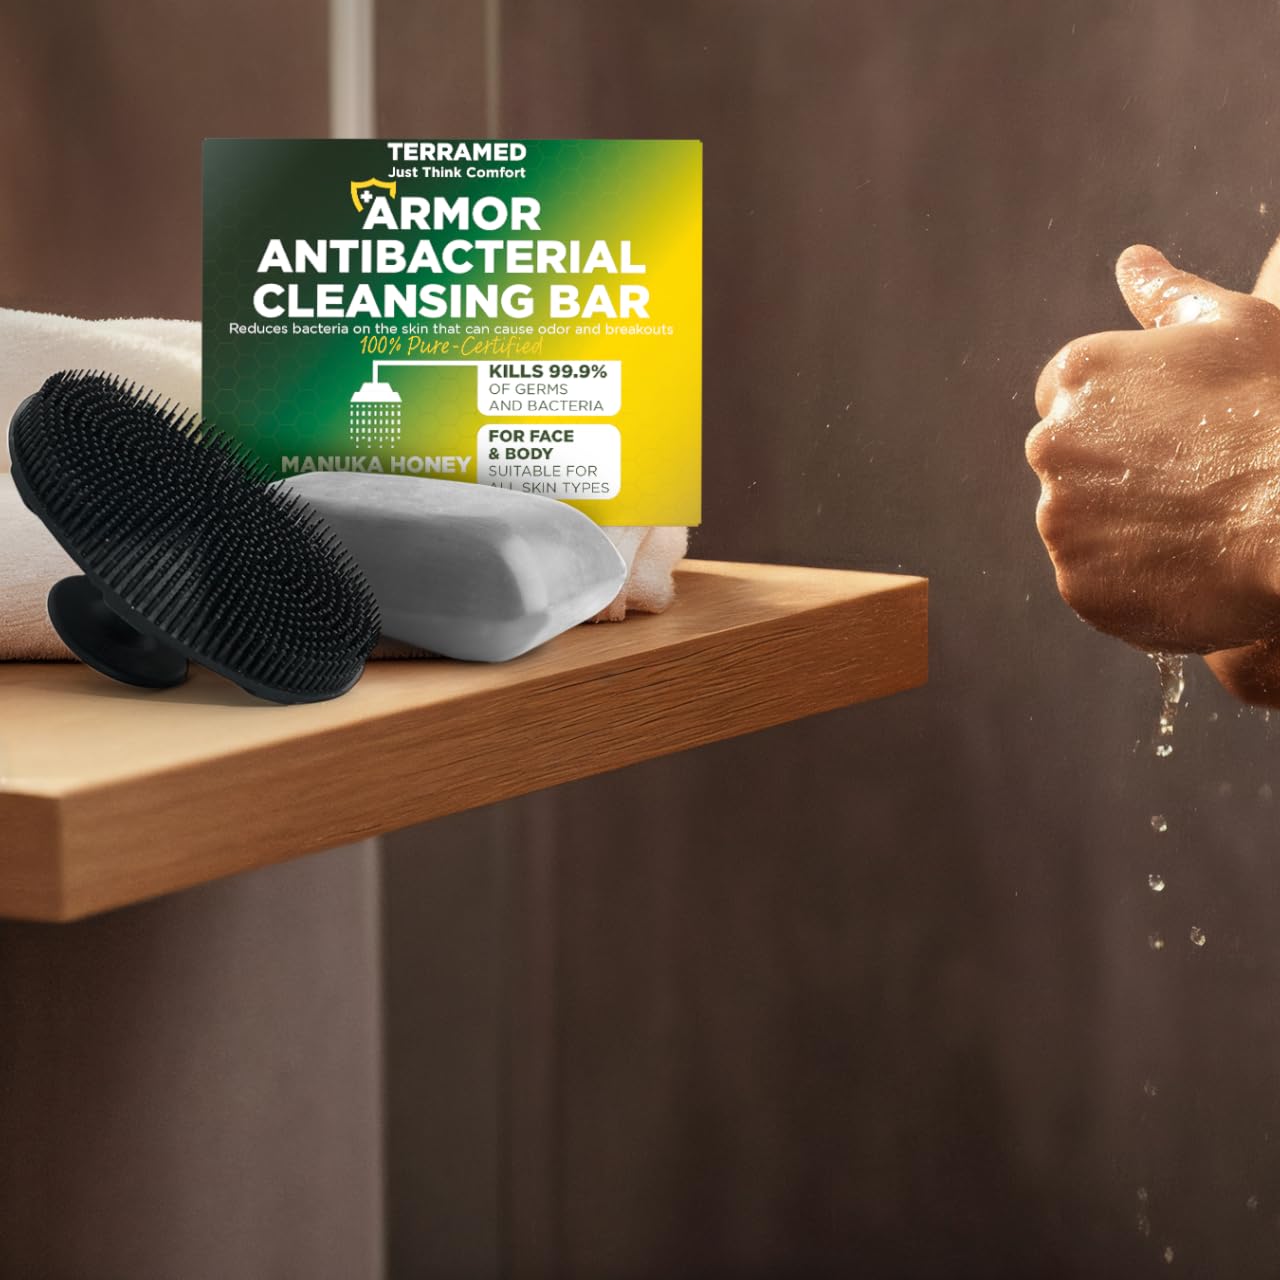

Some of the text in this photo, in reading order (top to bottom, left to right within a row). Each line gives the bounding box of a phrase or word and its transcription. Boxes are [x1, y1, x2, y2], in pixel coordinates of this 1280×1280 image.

[387, 142, 527, 161] TERRAMED
[388, 166, 526, 178] Just Think Comfort
[362, 196, 541, 231] ARMOR
[257, 239, 646, 274] ANTIBACTERIAL
[253, 284, 650, 319] CLEANSING BAR
[229, 322, 674, 335] Reduces bacteria on the skin that can cause odor and breakouts
[360, 335, 544, 357] 100% Pure-Certified
[489, 364, 608, 379] KILLS 99.9%
[489, 383, 568, 395] OF GERMS
[489, 400, 604, 412] AND BACTERIA
[489, 429, 574, 443] FOR FACE
[488, 447, 554, 460] & BODY
[281, 456, 472, 473] MANUKA HONEY
[488, 465, 598, 477] SUITABLE FOR
[522, 482, 557, 493] SKIN
[563, 482, 610, 493] TYPES
